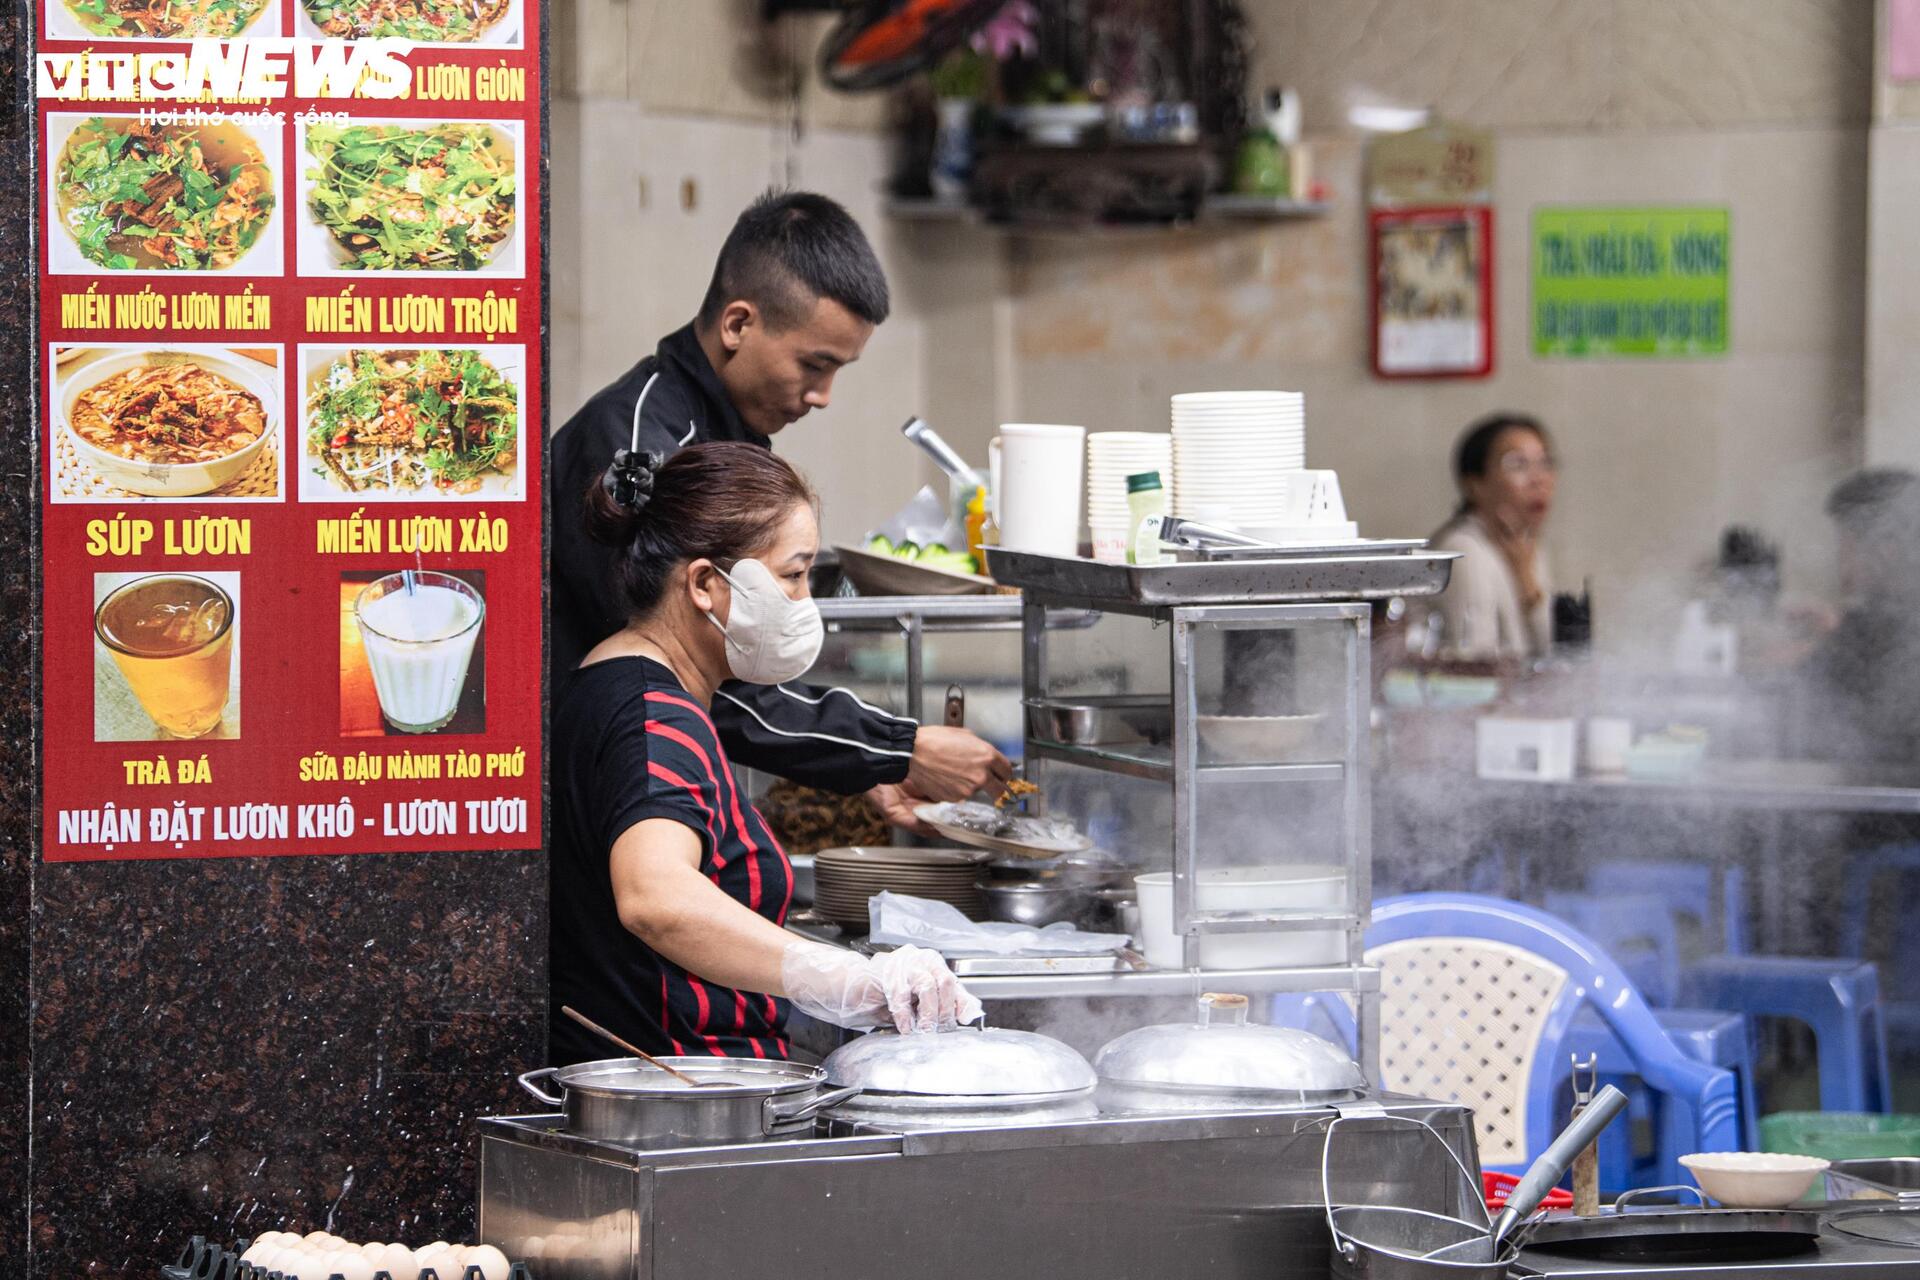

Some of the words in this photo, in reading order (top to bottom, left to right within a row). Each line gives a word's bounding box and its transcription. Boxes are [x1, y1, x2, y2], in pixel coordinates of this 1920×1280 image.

[416, 63, 471, 101] LƯƠN
[475, 59, 526, 102] GIÒN
[61, 281, 111, 329] MIẾN
[115, 283, 168, 330] NƯỚC
[171, 291, 220, 330] LƯƠN
[225, 282, 271, 330] MỀM
[306, 284, 372, 333] MIẾN
[379, 293, 445, 333] LƯƠN
[451, 290, 517, 341] TRỘN
[86, 512, 154, 556] SÚP
[164, 516, 251, 556] LƯƠN
[316, 507, 382, 554] MIẾN
[388, 515, 452, 553] LƯƠN
[458, 511, 509, 553] XÀO
[123, 755, 171, 785] TRÀ
[177, 754, 212, 784] ĐÁ
[299, 751, 339, 782] SỮA
[343, 751, 382, 785] ĐẬU
[387, 750, 441, 779] NÀNH
[445, 749, 481, 778] TÀO
[486, 746, 526, 778] PHỚ
[58, 802, 141, 850] NHẬN
[149, 800, 205, 849] ĐẶT
[213, 803, 288, 841] LƯƠN
[297, 797, 355, 839] KHÔ
[383, 798, 457, 837] LƯƠN
[465, 797, 527, 835] TƯƠI
